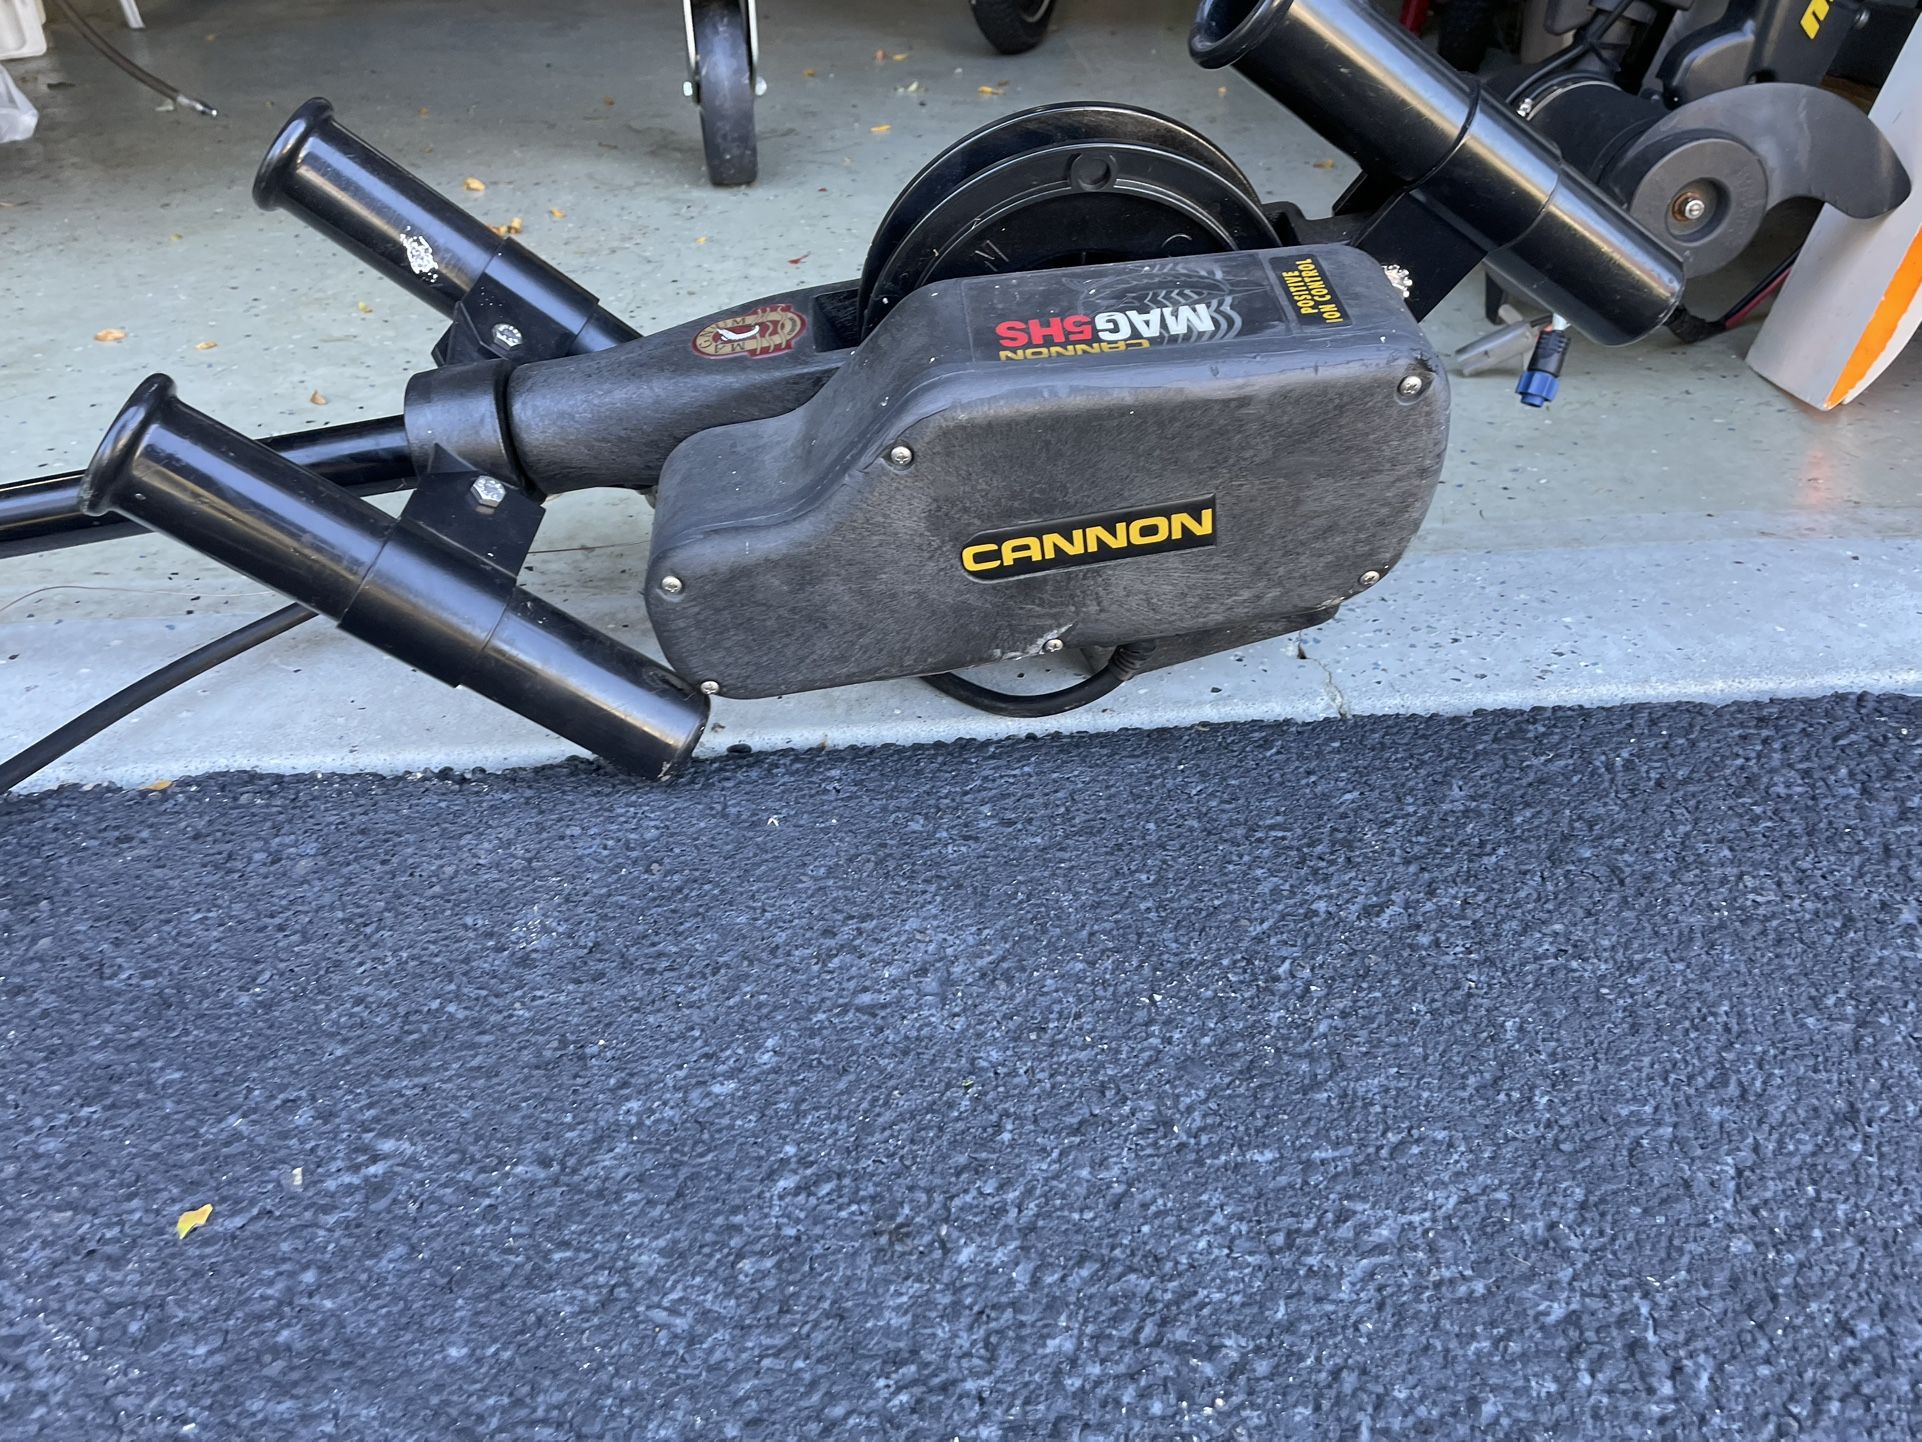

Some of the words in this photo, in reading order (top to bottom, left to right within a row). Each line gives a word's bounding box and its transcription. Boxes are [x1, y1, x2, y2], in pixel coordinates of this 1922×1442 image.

[1282, 271, 1319, 315] POSITIVE
[1295, 258, 1332, 301] CONTROL
[1318, 303, 1344, 323] ION
[999, 339, 1150, 361] CANNON
[961, 508, 1213, 572] CANNON
